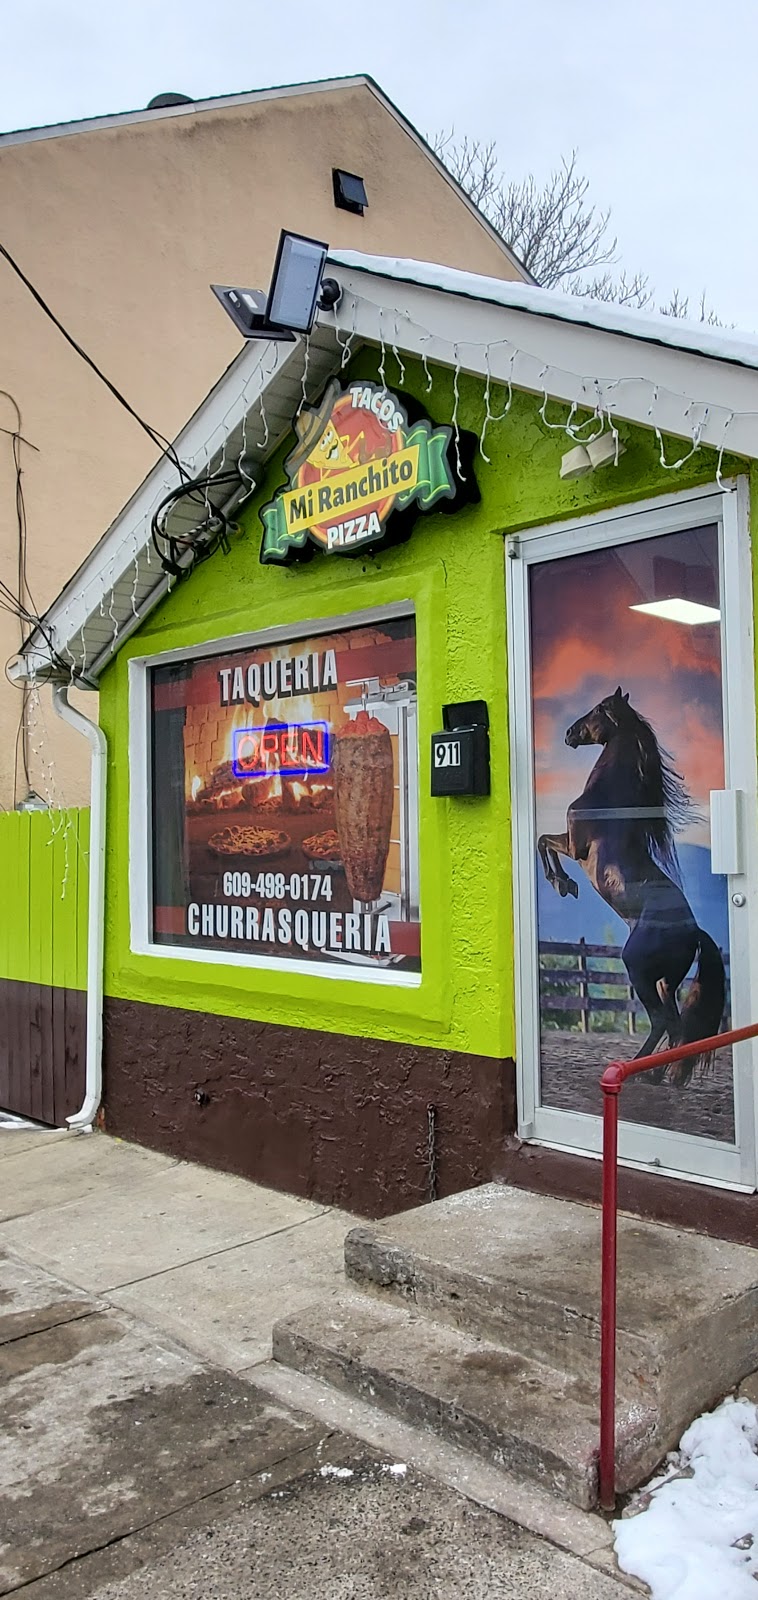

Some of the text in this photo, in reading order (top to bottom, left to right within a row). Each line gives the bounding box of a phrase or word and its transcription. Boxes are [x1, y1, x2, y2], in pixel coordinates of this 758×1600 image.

[350, 387, 404, 433] TACOS
[289, 458, 413, 524] Mi Ranchito
[327, 512, 381, 549] PIZZA
[219, 649, 338, 705] TAQUERIA
[237, 731, 323, 769] OPEN
[436, 743, 459, 766] 911
[223, 871, 333, 901] 609-498-0174
[187, 902, 392, 953] CHURRASQUERIA
